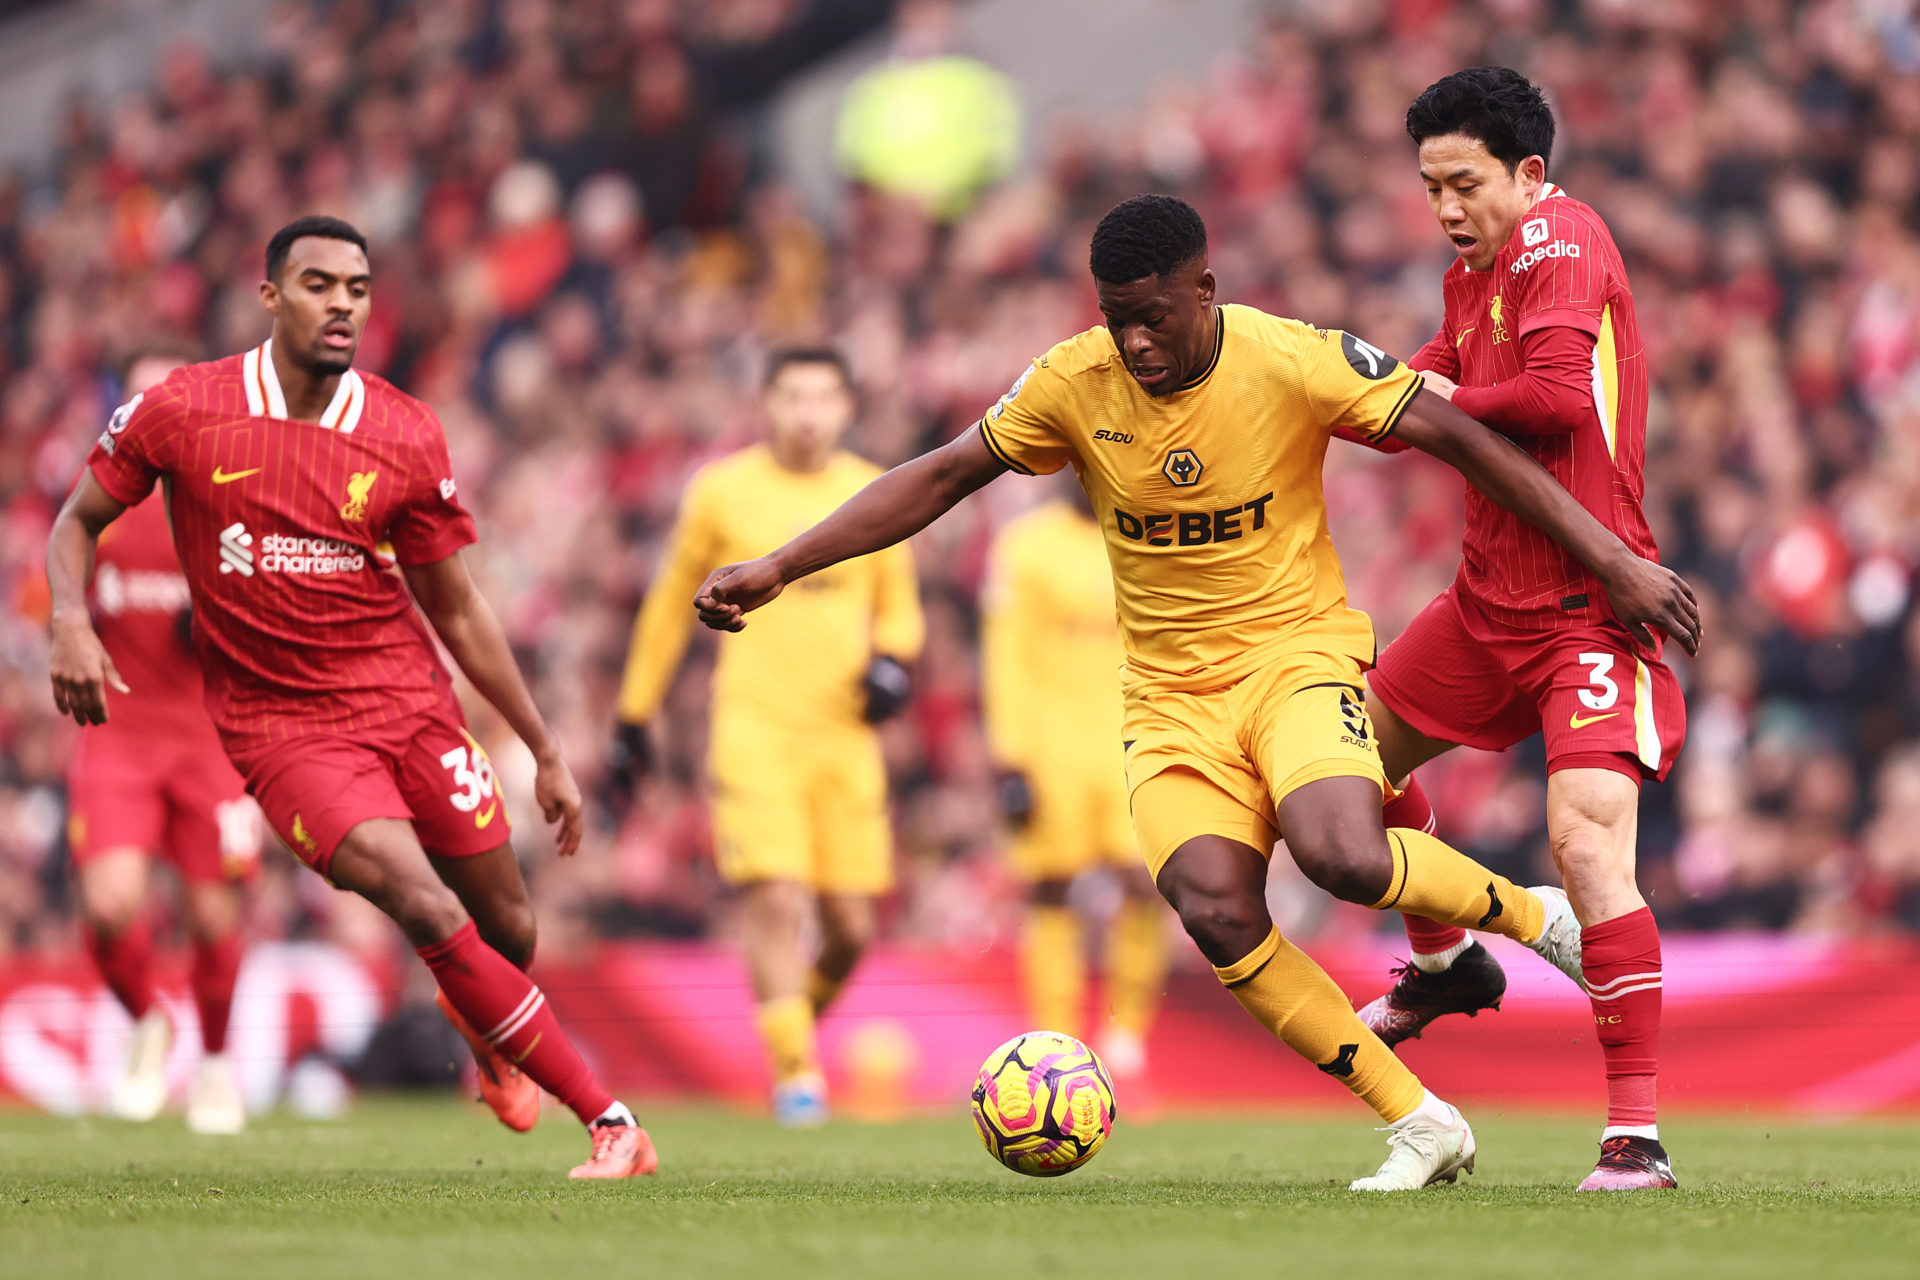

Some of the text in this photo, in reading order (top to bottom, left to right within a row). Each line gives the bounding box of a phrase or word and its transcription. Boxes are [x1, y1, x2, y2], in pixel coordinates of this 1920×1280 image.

[1492, 329, 1511, 345] LFC
[1093, 429, 1134, 444] SUDU
[1114, 491, 1274, 547] DEBET
[261, 551, 364, 574] chartered
[1577, 652, 1619, 710] 3
[1340, 735, 1371, 752] SUDU
